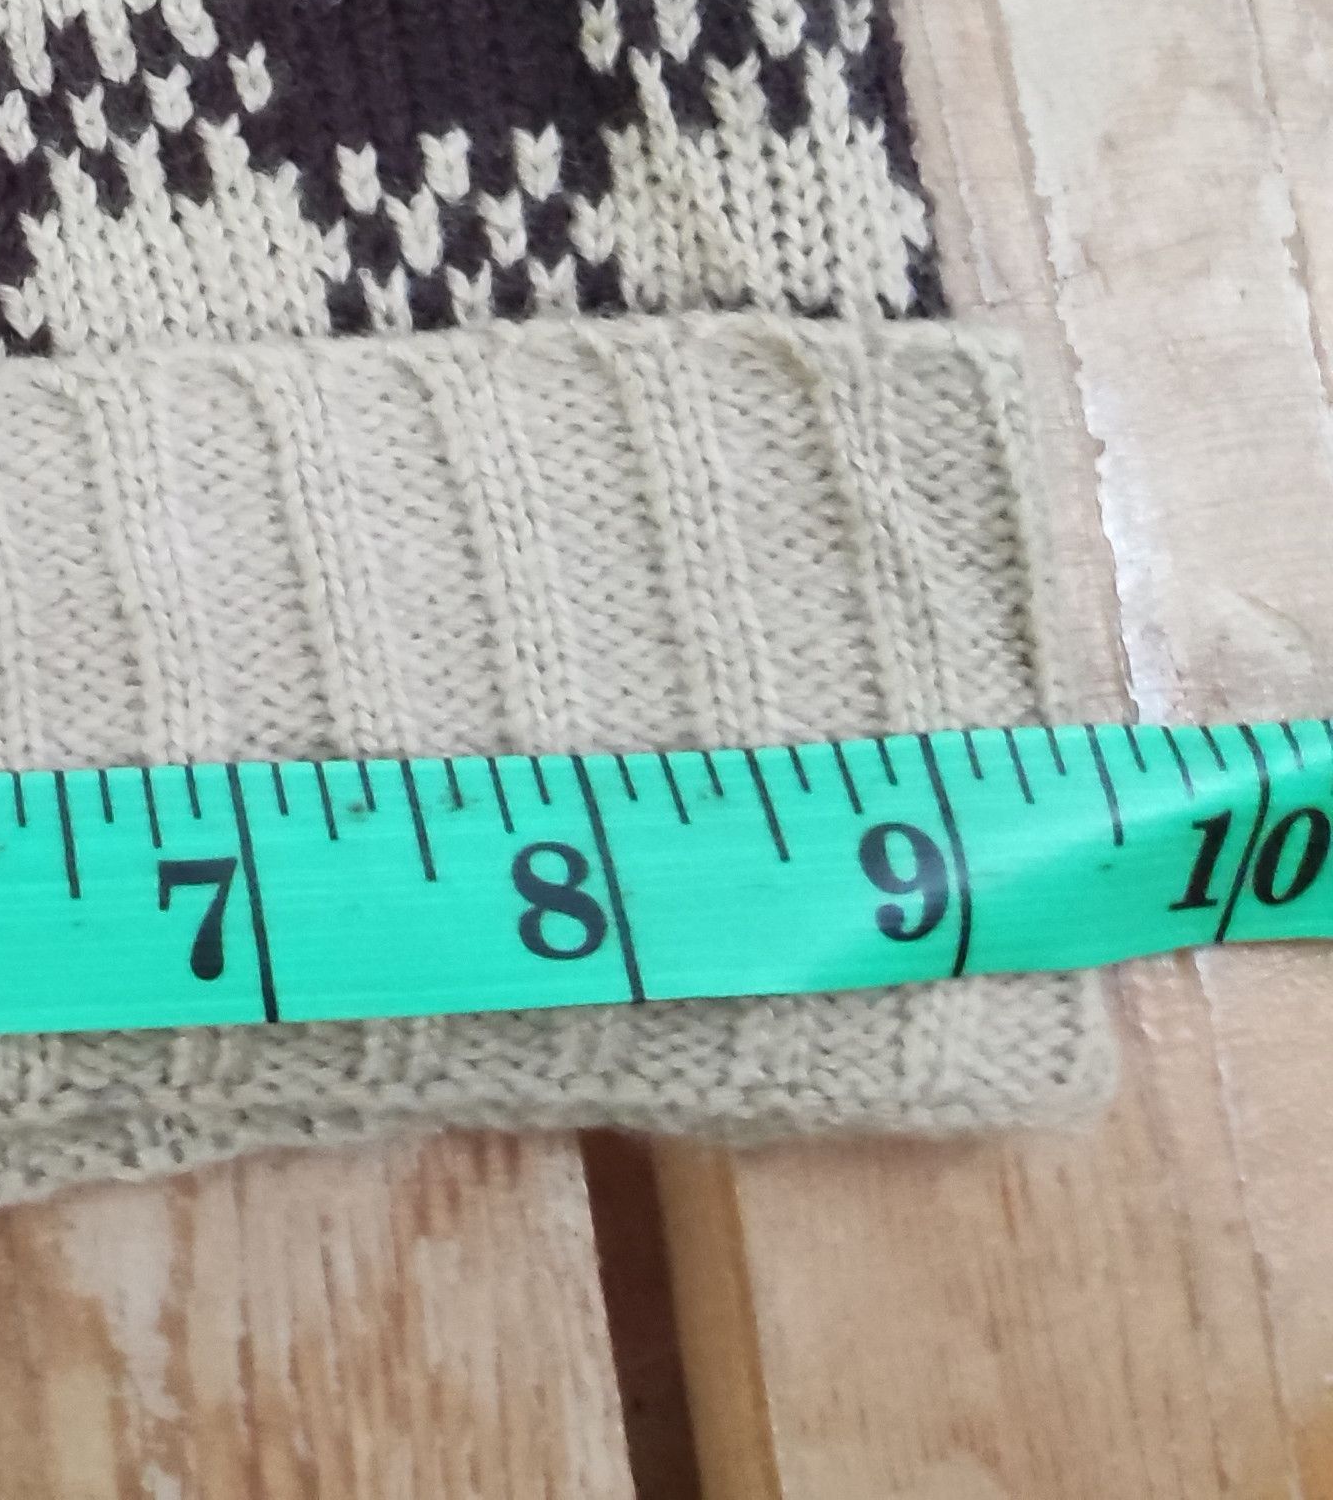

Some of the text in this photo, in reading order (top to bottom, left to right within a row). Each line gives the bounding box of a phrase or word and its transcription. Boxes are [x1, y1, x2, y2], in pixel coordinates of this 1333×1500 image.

[157, 856, 238, 981] 7
[510, 840, 608, 960] 8
[858, 821, 949, 943] 9
[1168, 805, 1332, 912] 10
